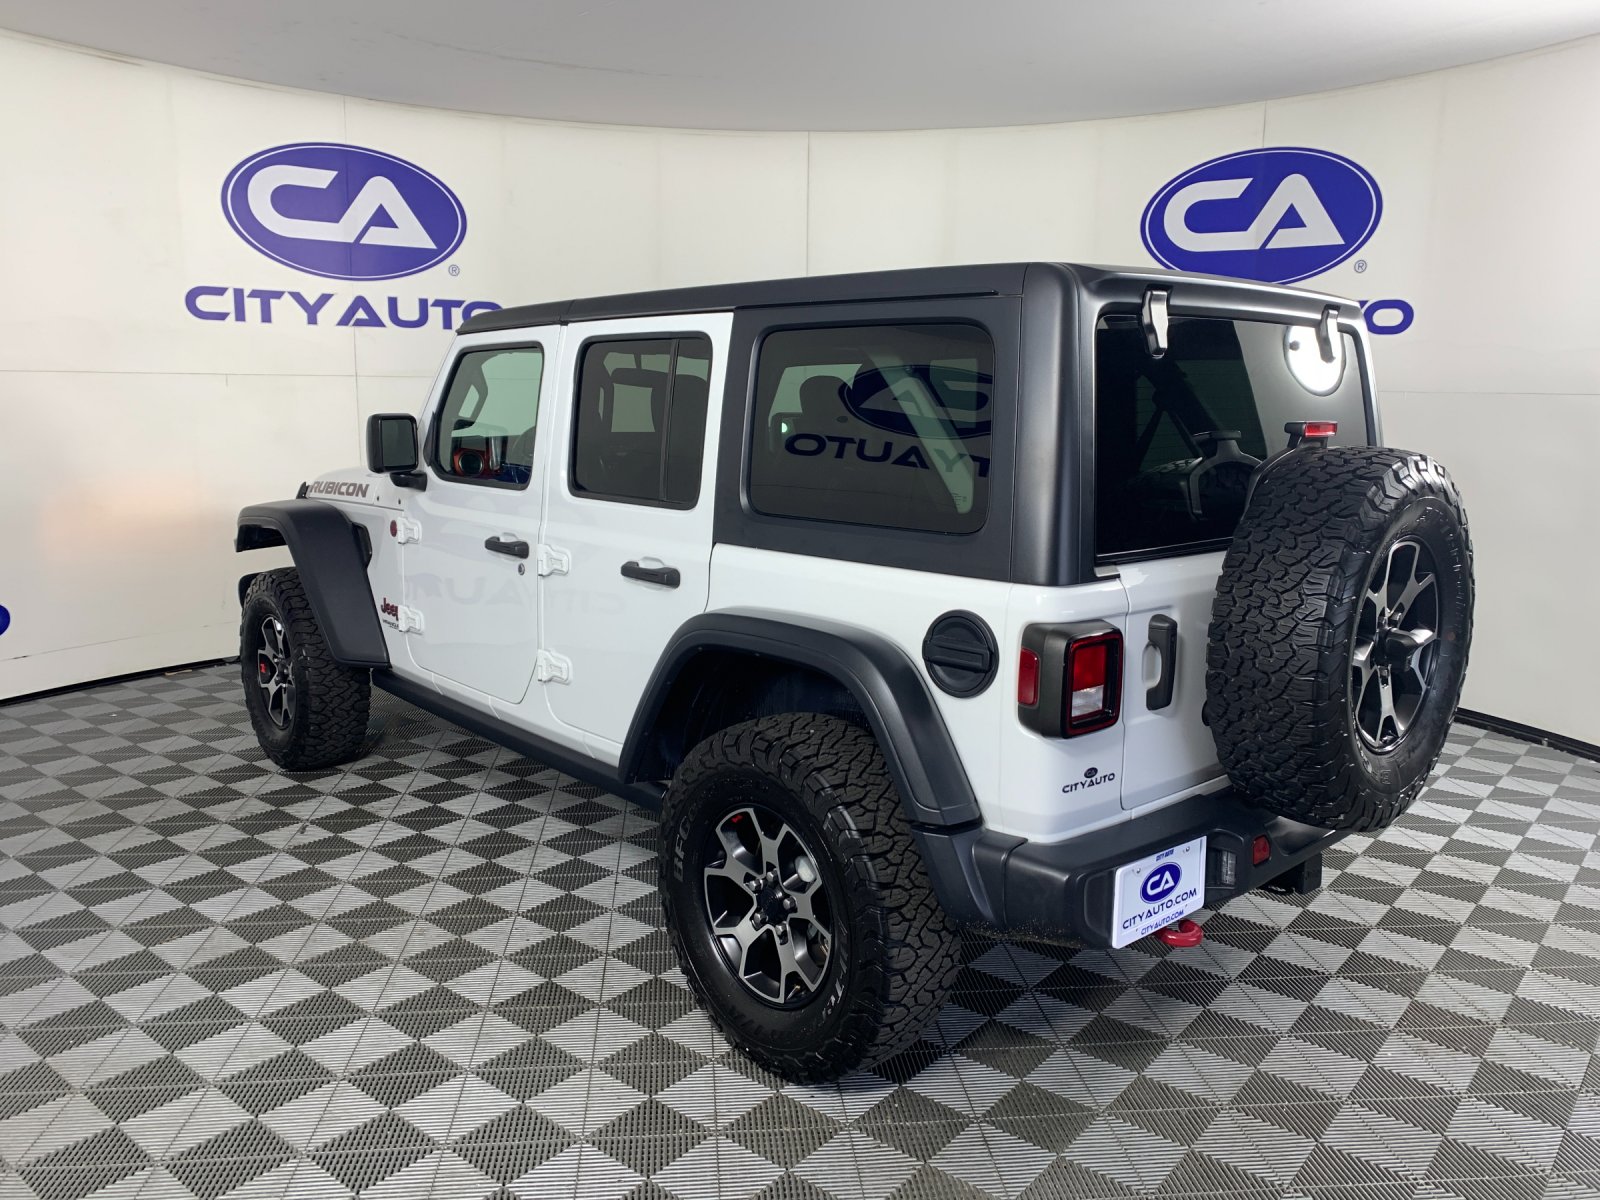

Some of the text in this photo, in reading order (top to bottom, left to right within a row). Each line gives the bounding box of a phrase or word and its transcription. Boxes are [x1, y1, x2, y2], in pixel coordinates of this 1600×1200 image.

[246, 163, 439, 250] CA
[1162, 172, 1346, 253] CA
[310, 480, 370, 498] RUBICON
[1146, 870, 1176, 896] CA
[1122, 887, 1197, 930] CITYAUTO.COM
[1140, 909, 1185, 936] CITYAUTO.COM
